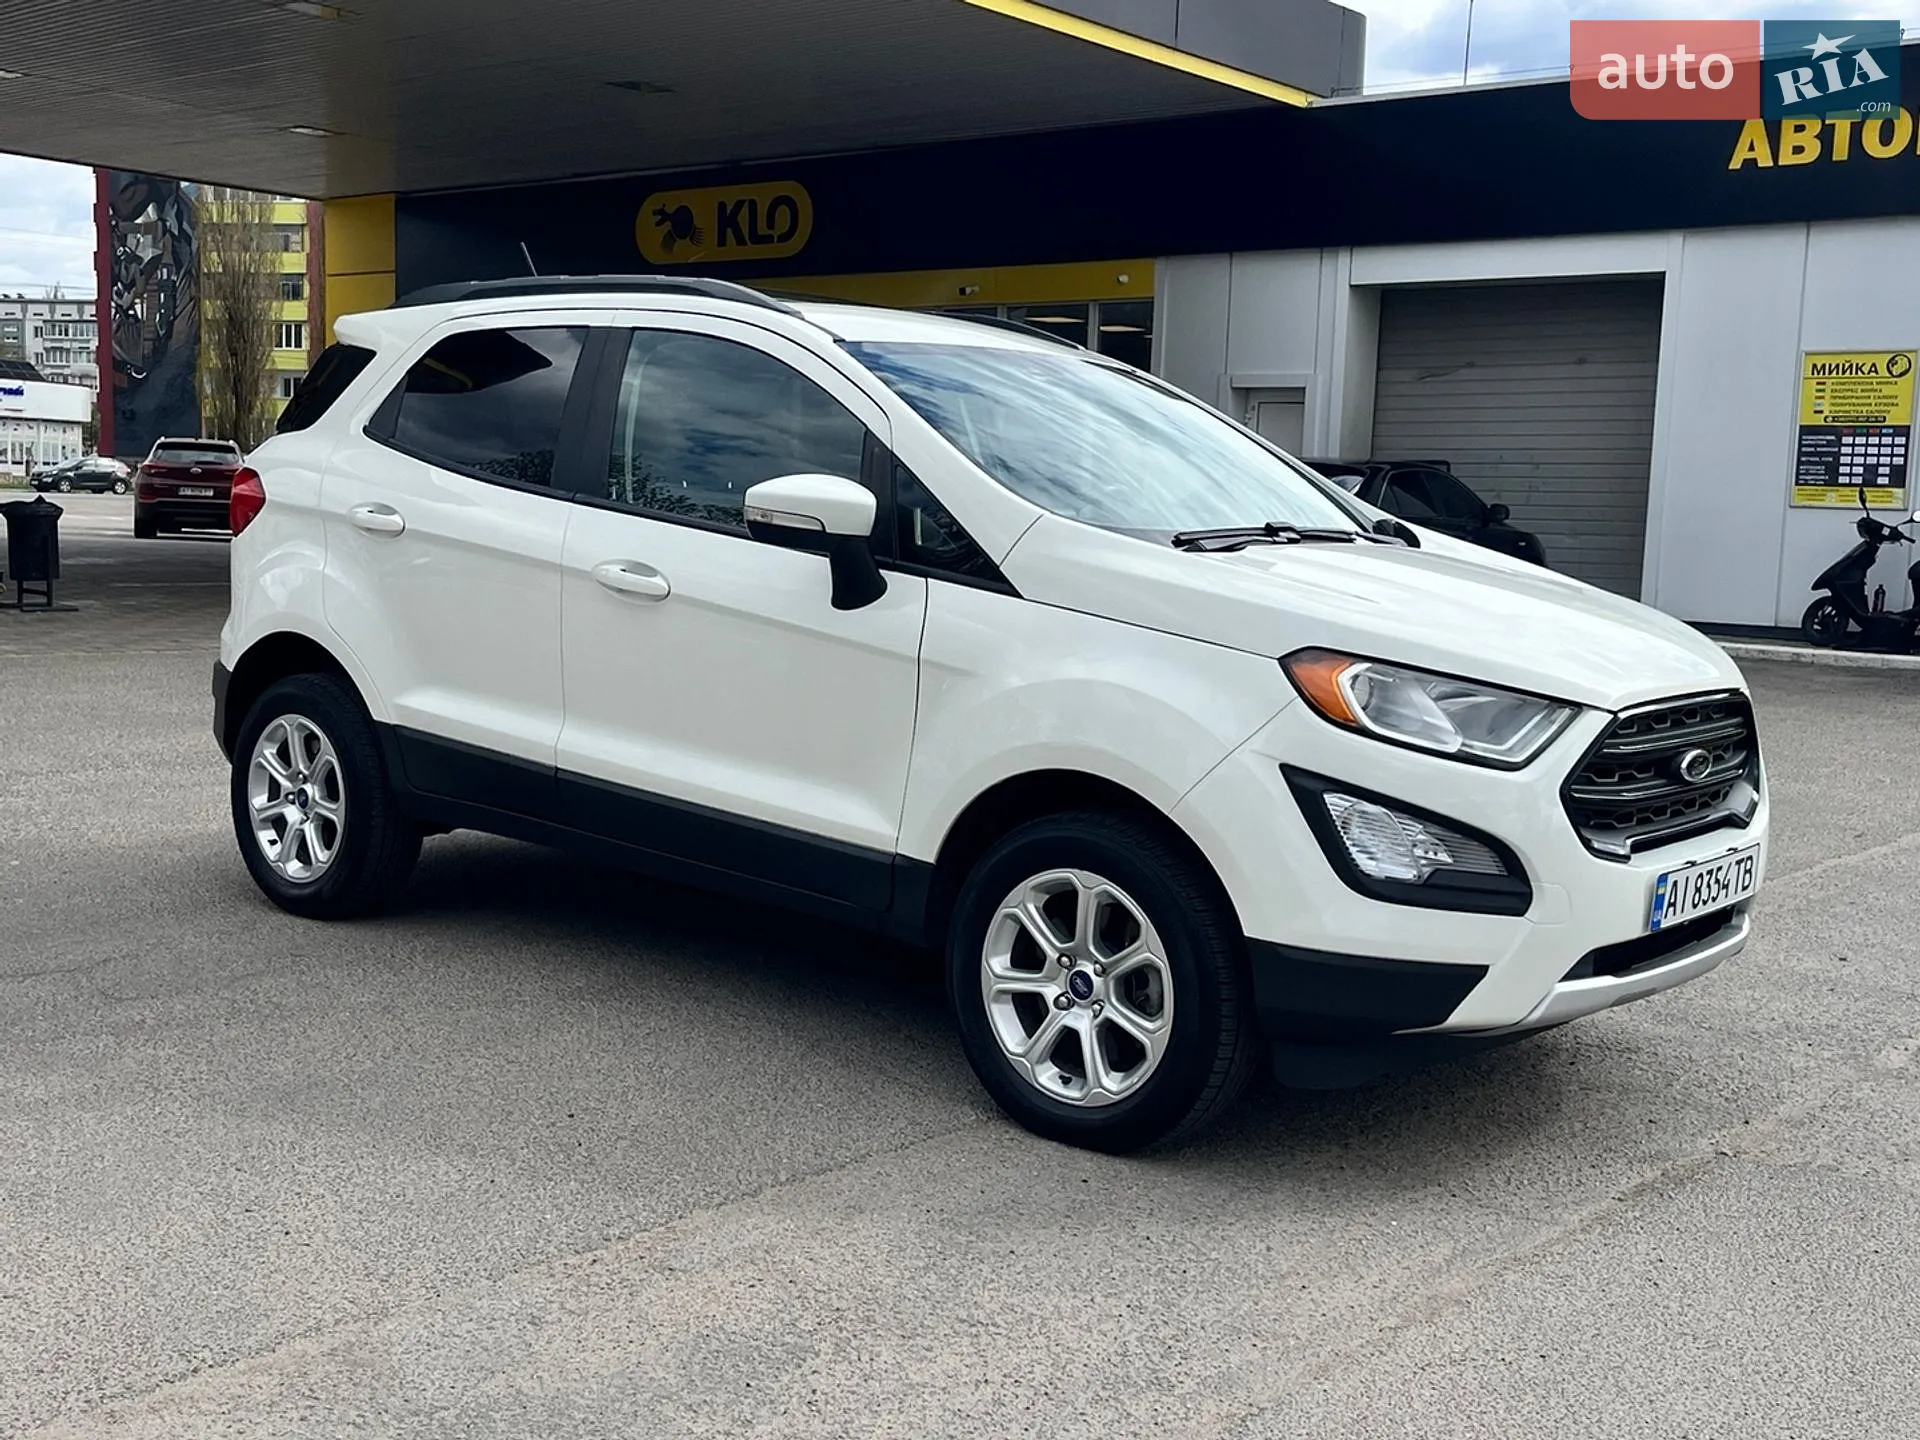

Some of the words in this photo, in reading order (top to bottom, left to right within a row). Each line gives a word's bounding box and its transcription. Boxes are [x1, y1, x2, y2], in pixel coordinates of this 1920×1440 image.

[1727, 103, 1920, 170] АВТО
[716, 194, 800, 248] KLO
[1811, 359, 1879, 376] МИЙКА
[1664, 876, 1689, 919] AI
[1691, 862, 1732, 910] 8354
[1735, 854, 1754, 895] TB
